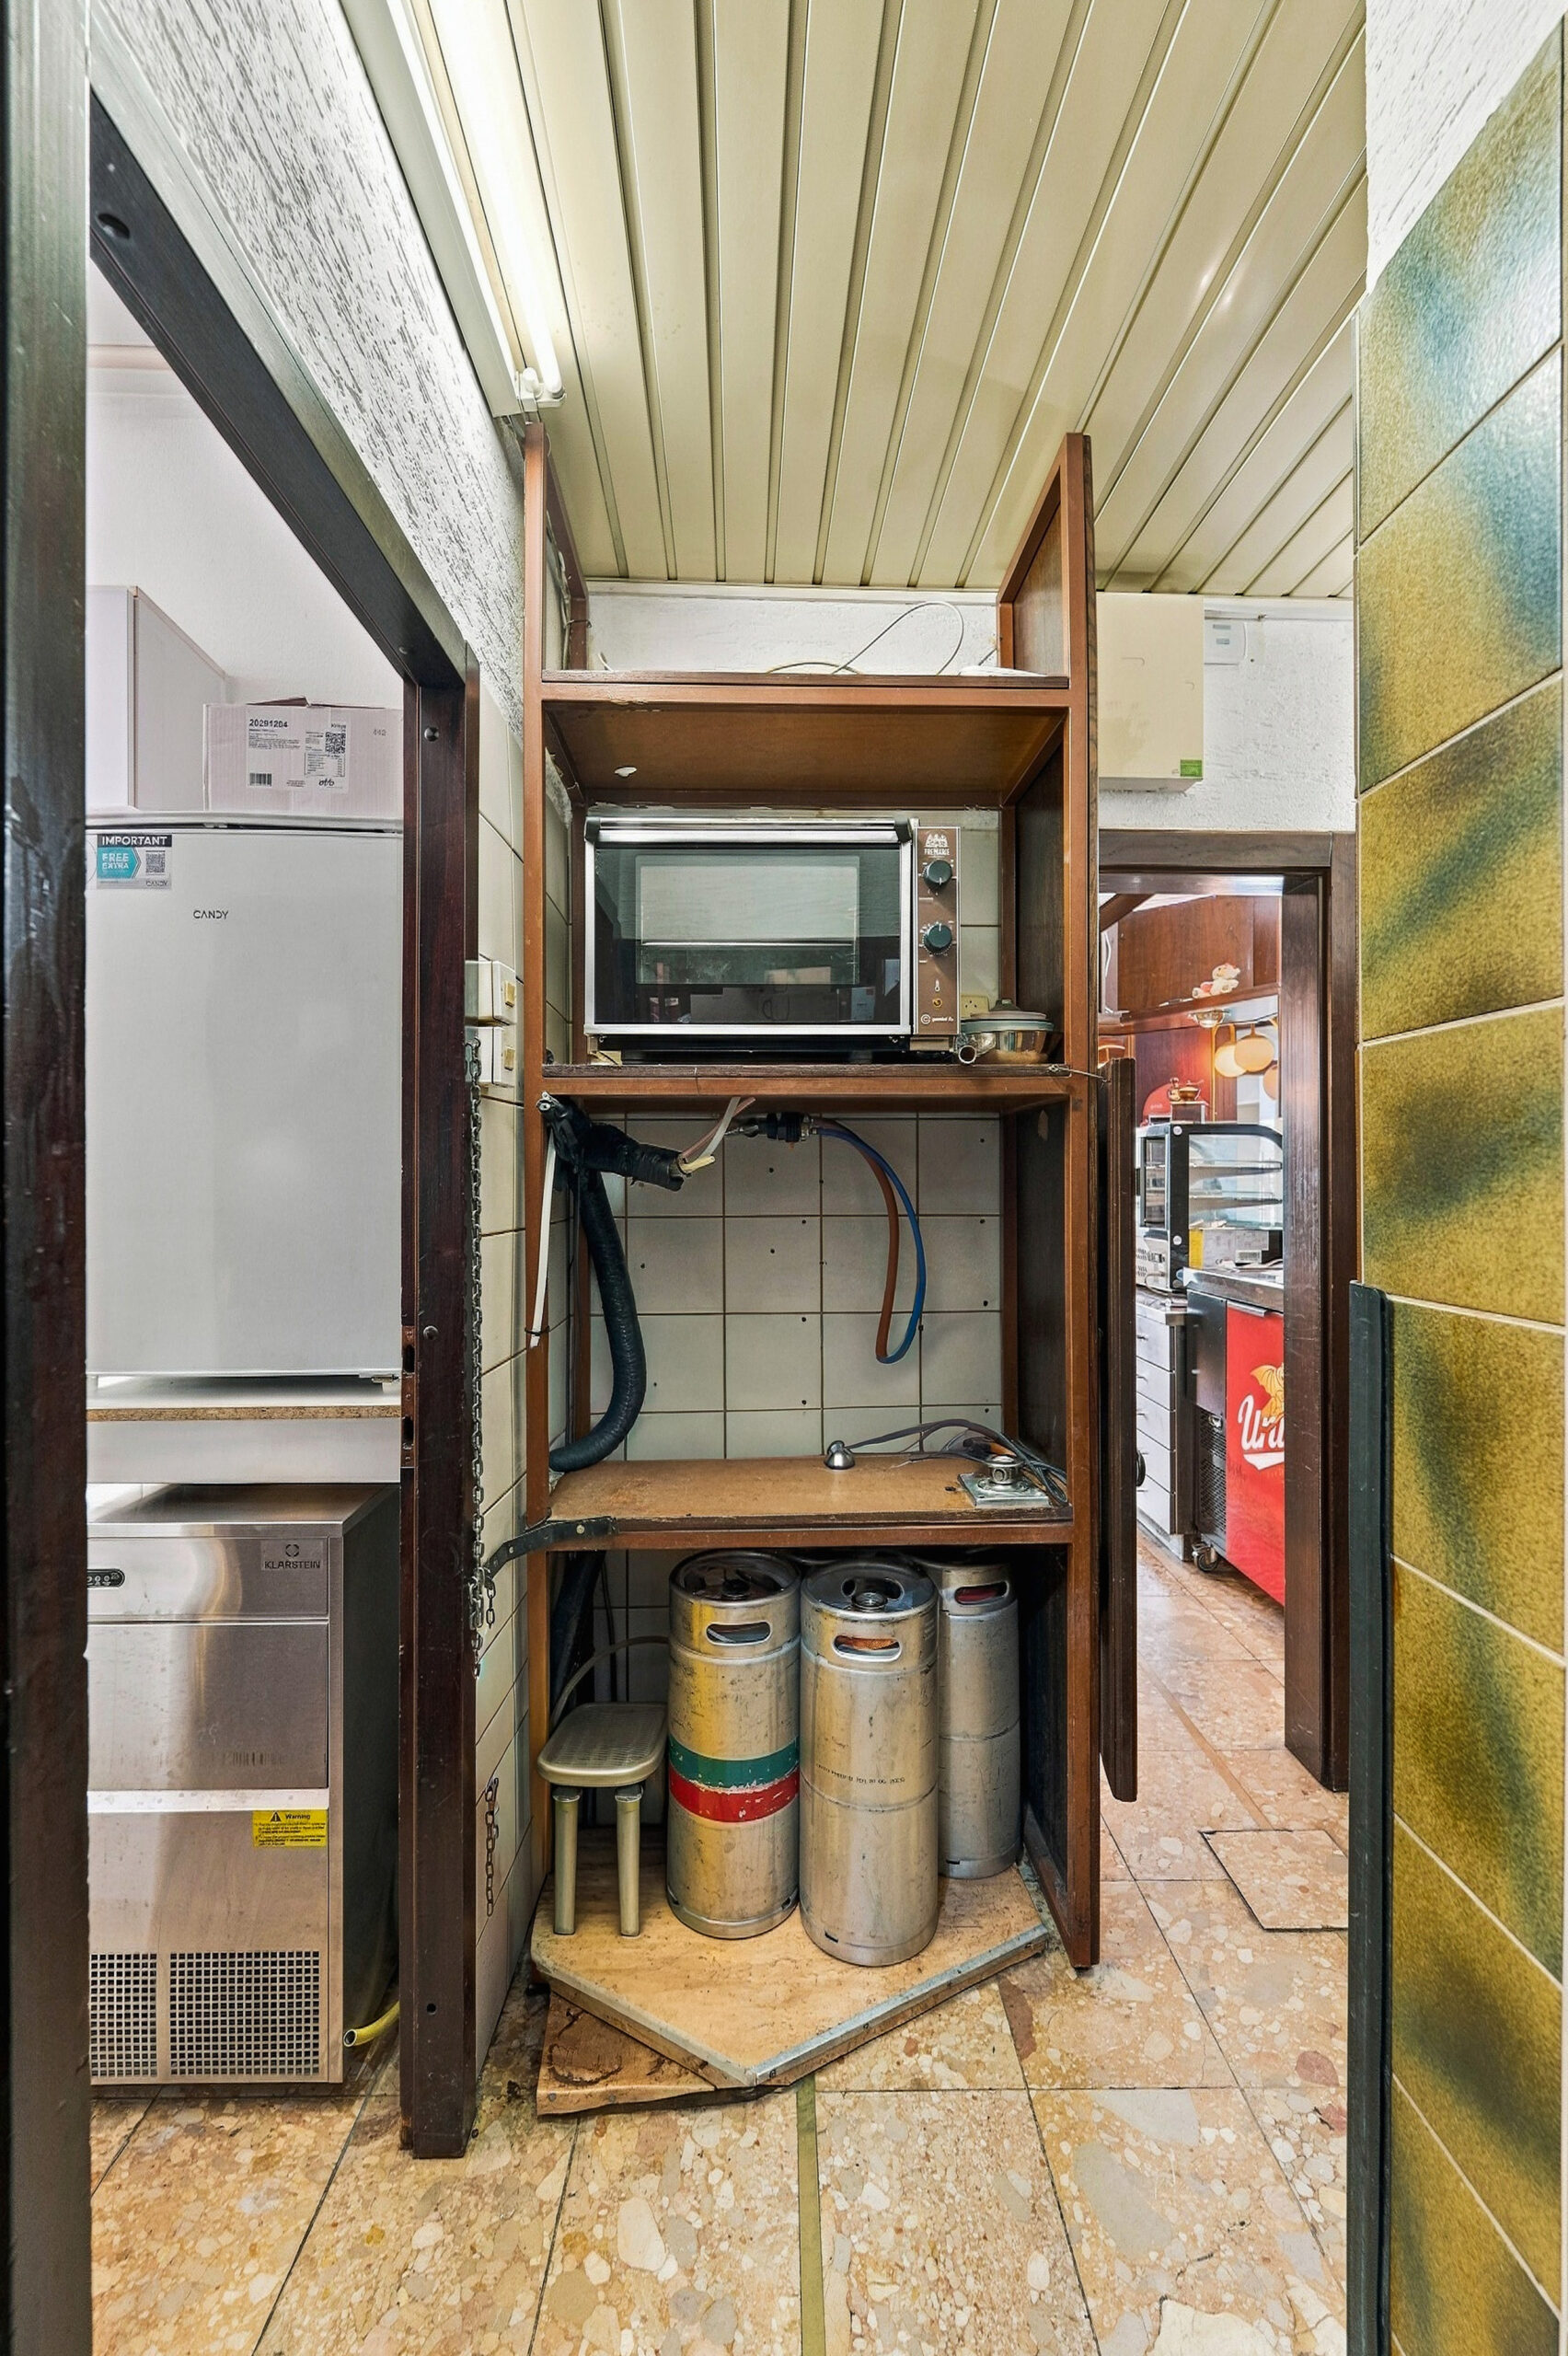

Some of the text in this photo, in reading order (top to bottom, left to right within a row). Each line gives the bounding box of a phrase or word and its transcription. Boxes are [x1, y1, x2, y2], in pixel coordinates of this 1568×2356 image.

[248, 719, 288, 728] 20291204
[102, 836, 167, 846] IMPORTANT
[102, 852, 129, 862] FREE
[193, 909, 229, 919] CANDY
[264, 1560, 321, 1569] KLARSTEIN
